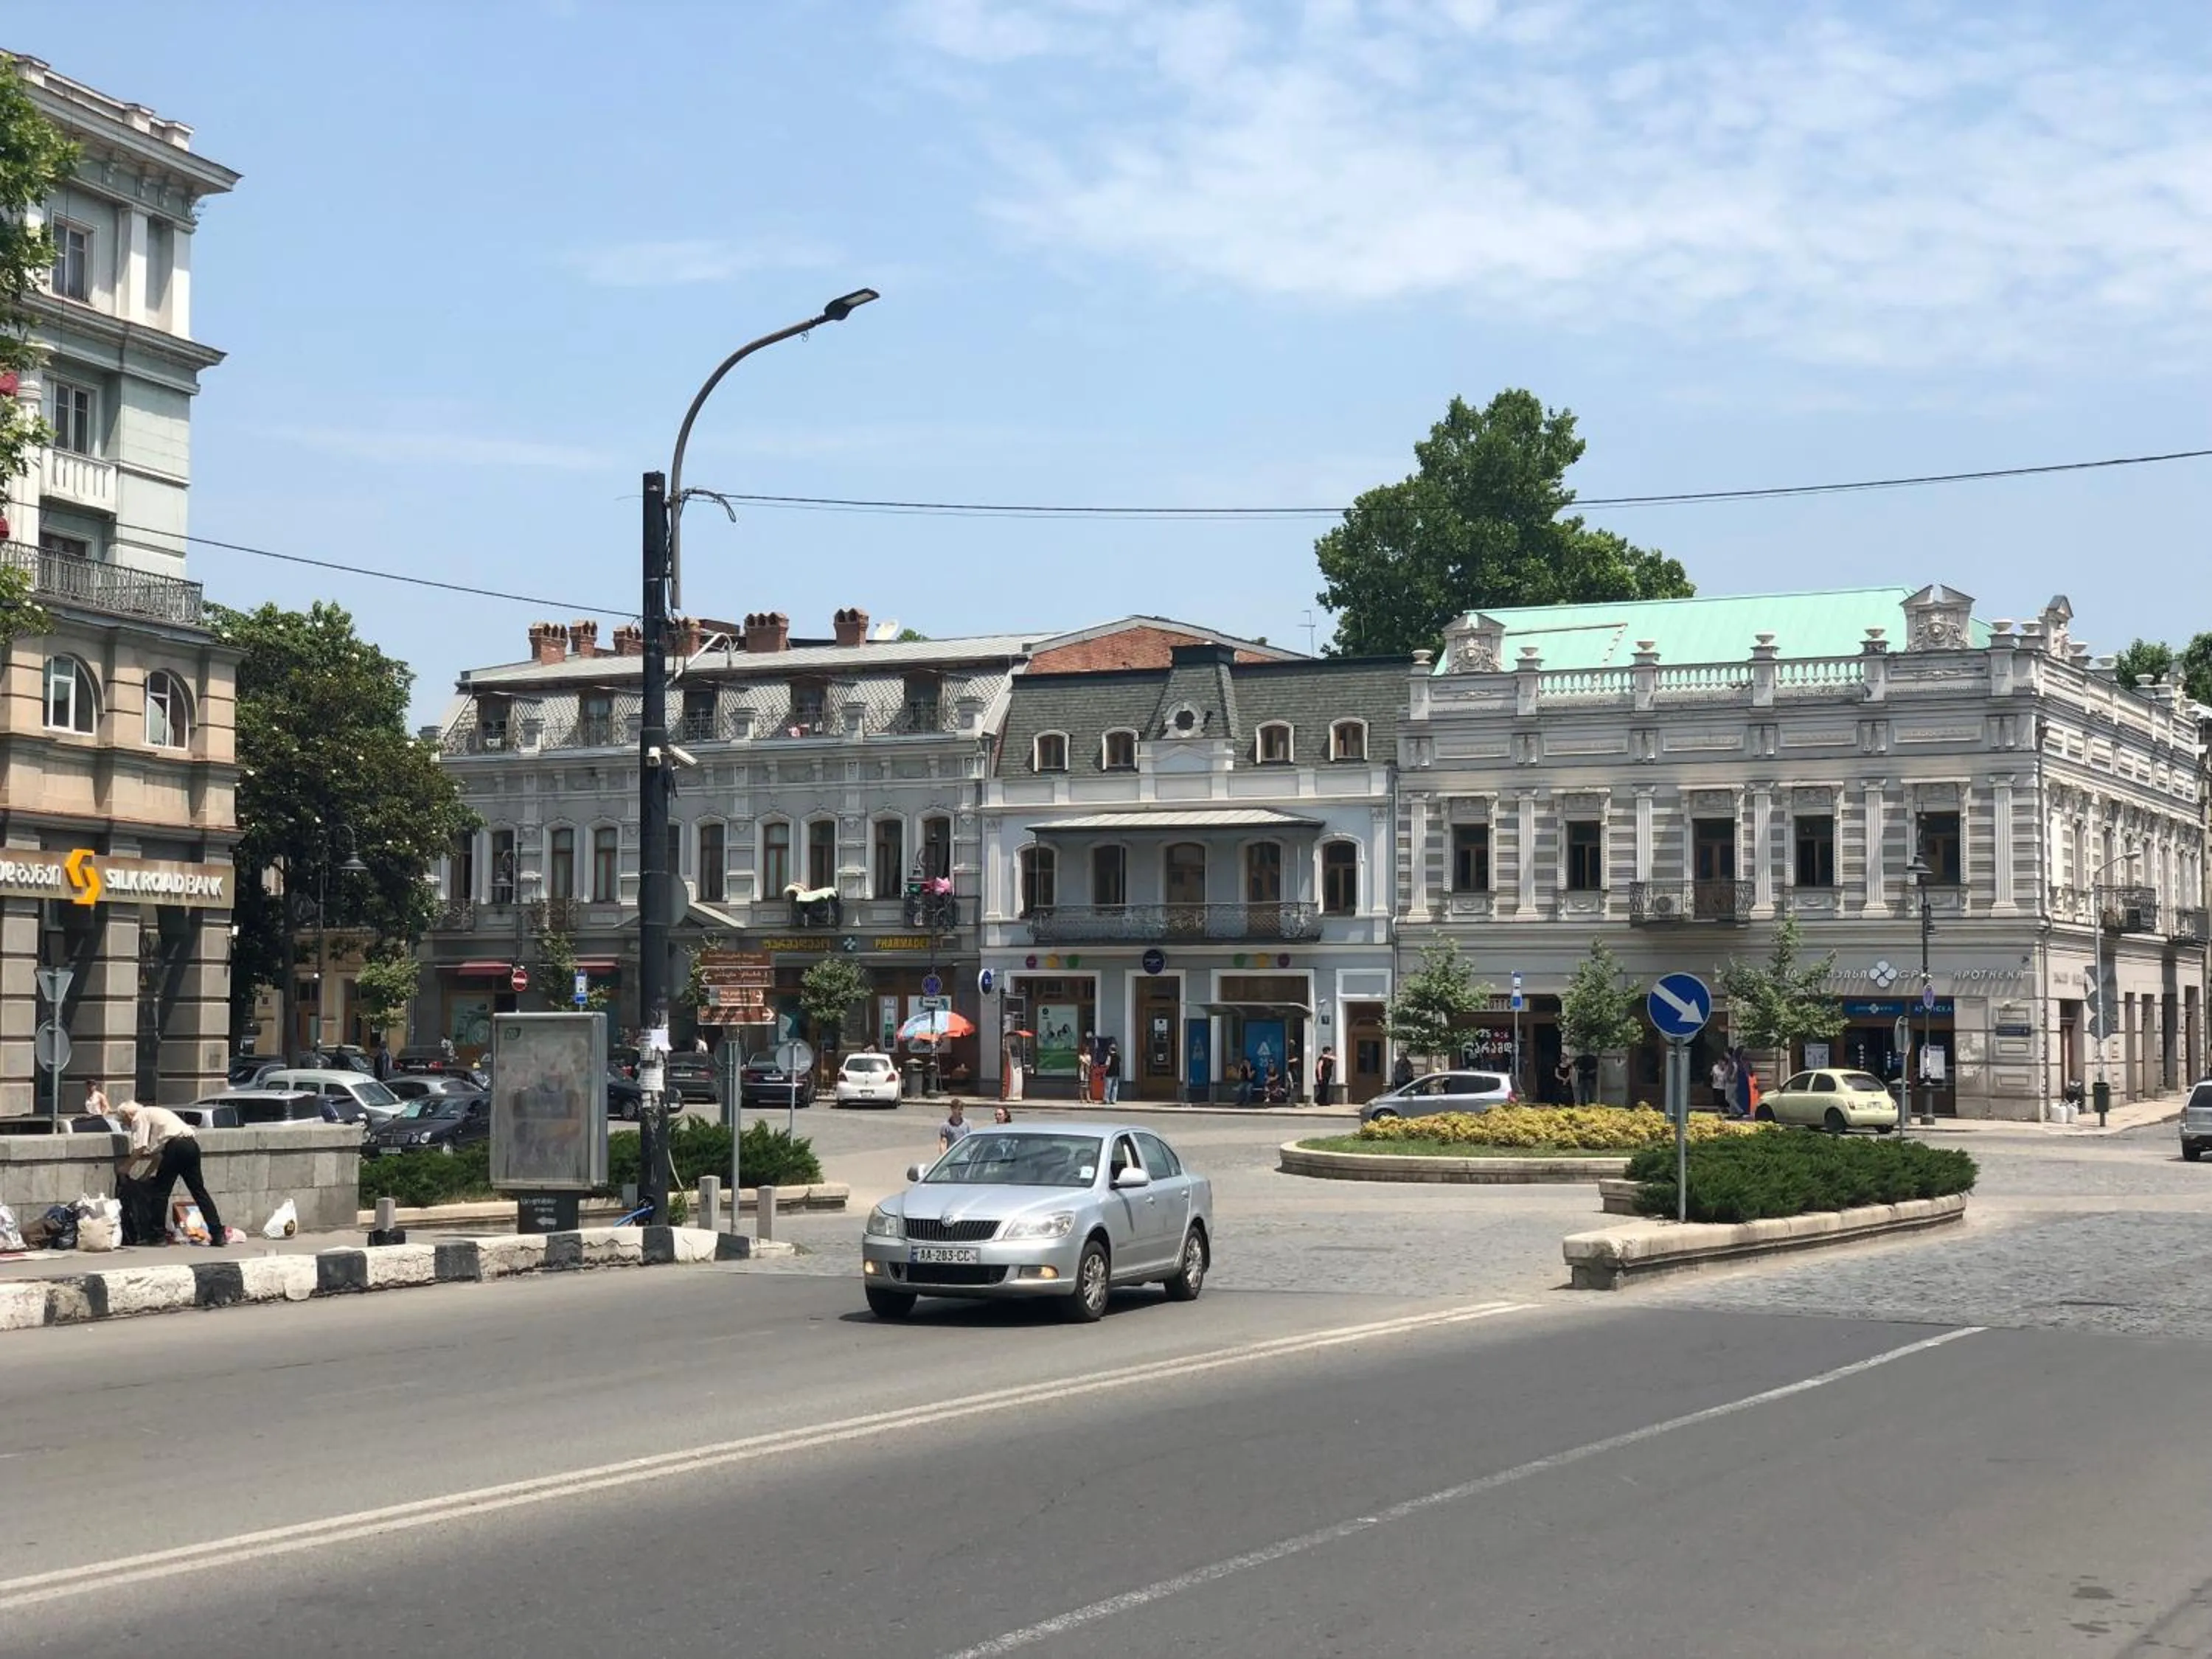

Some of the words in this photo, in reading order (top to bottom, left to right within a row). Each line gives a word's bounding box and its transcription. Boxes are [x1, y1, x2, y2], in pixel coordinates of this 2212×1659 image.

[105, 869, 139, 891] SILK
[140, 871, 184, 893] ROAD
[186, 874, 223, 895] BANK
